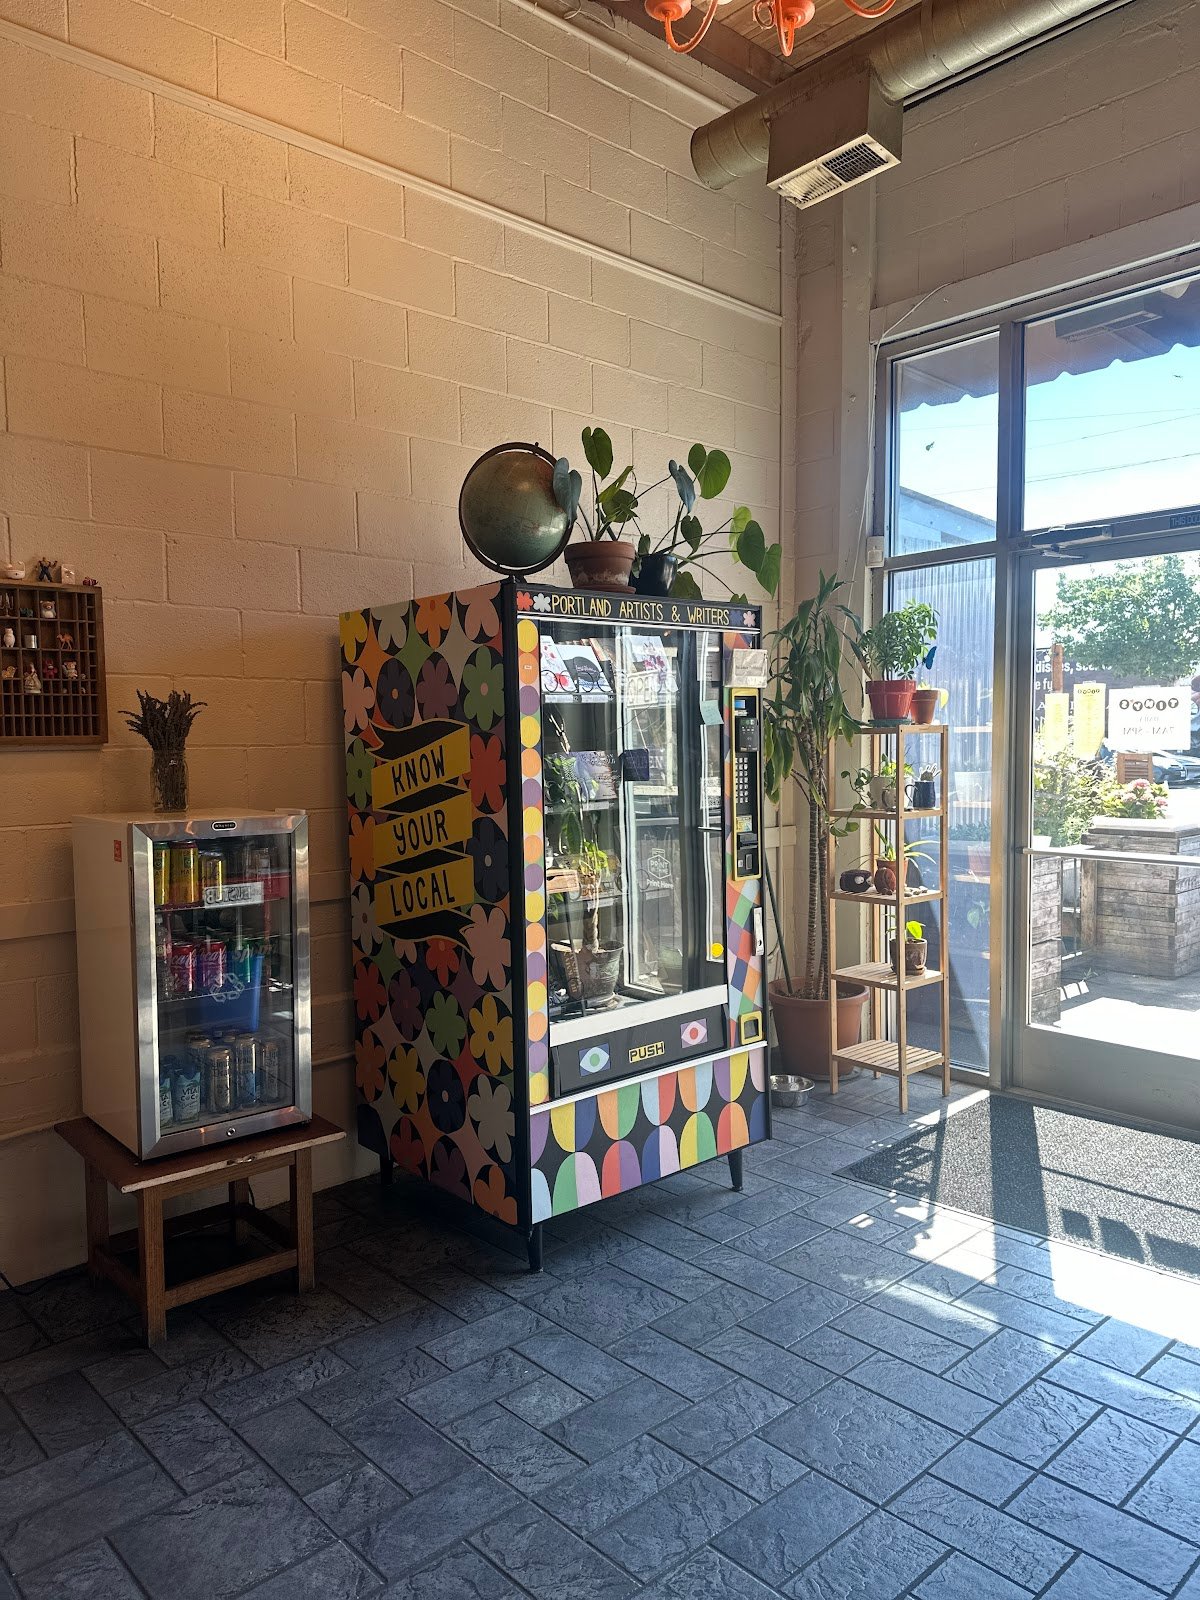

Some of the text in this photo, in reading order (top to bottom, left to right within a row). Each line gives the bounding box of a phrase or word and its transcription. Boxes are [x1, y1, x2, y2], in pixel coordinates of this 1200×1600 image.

[551, 594, 730, 626] PORTLAND ARTISTS & WRITERS
[391, 744, 445, 796] KNOW
[393, 809, 449, 856] YOUR
[390, 869, 456, 917] LOCAL
[630, 1042, 663, 1061] PUSH
